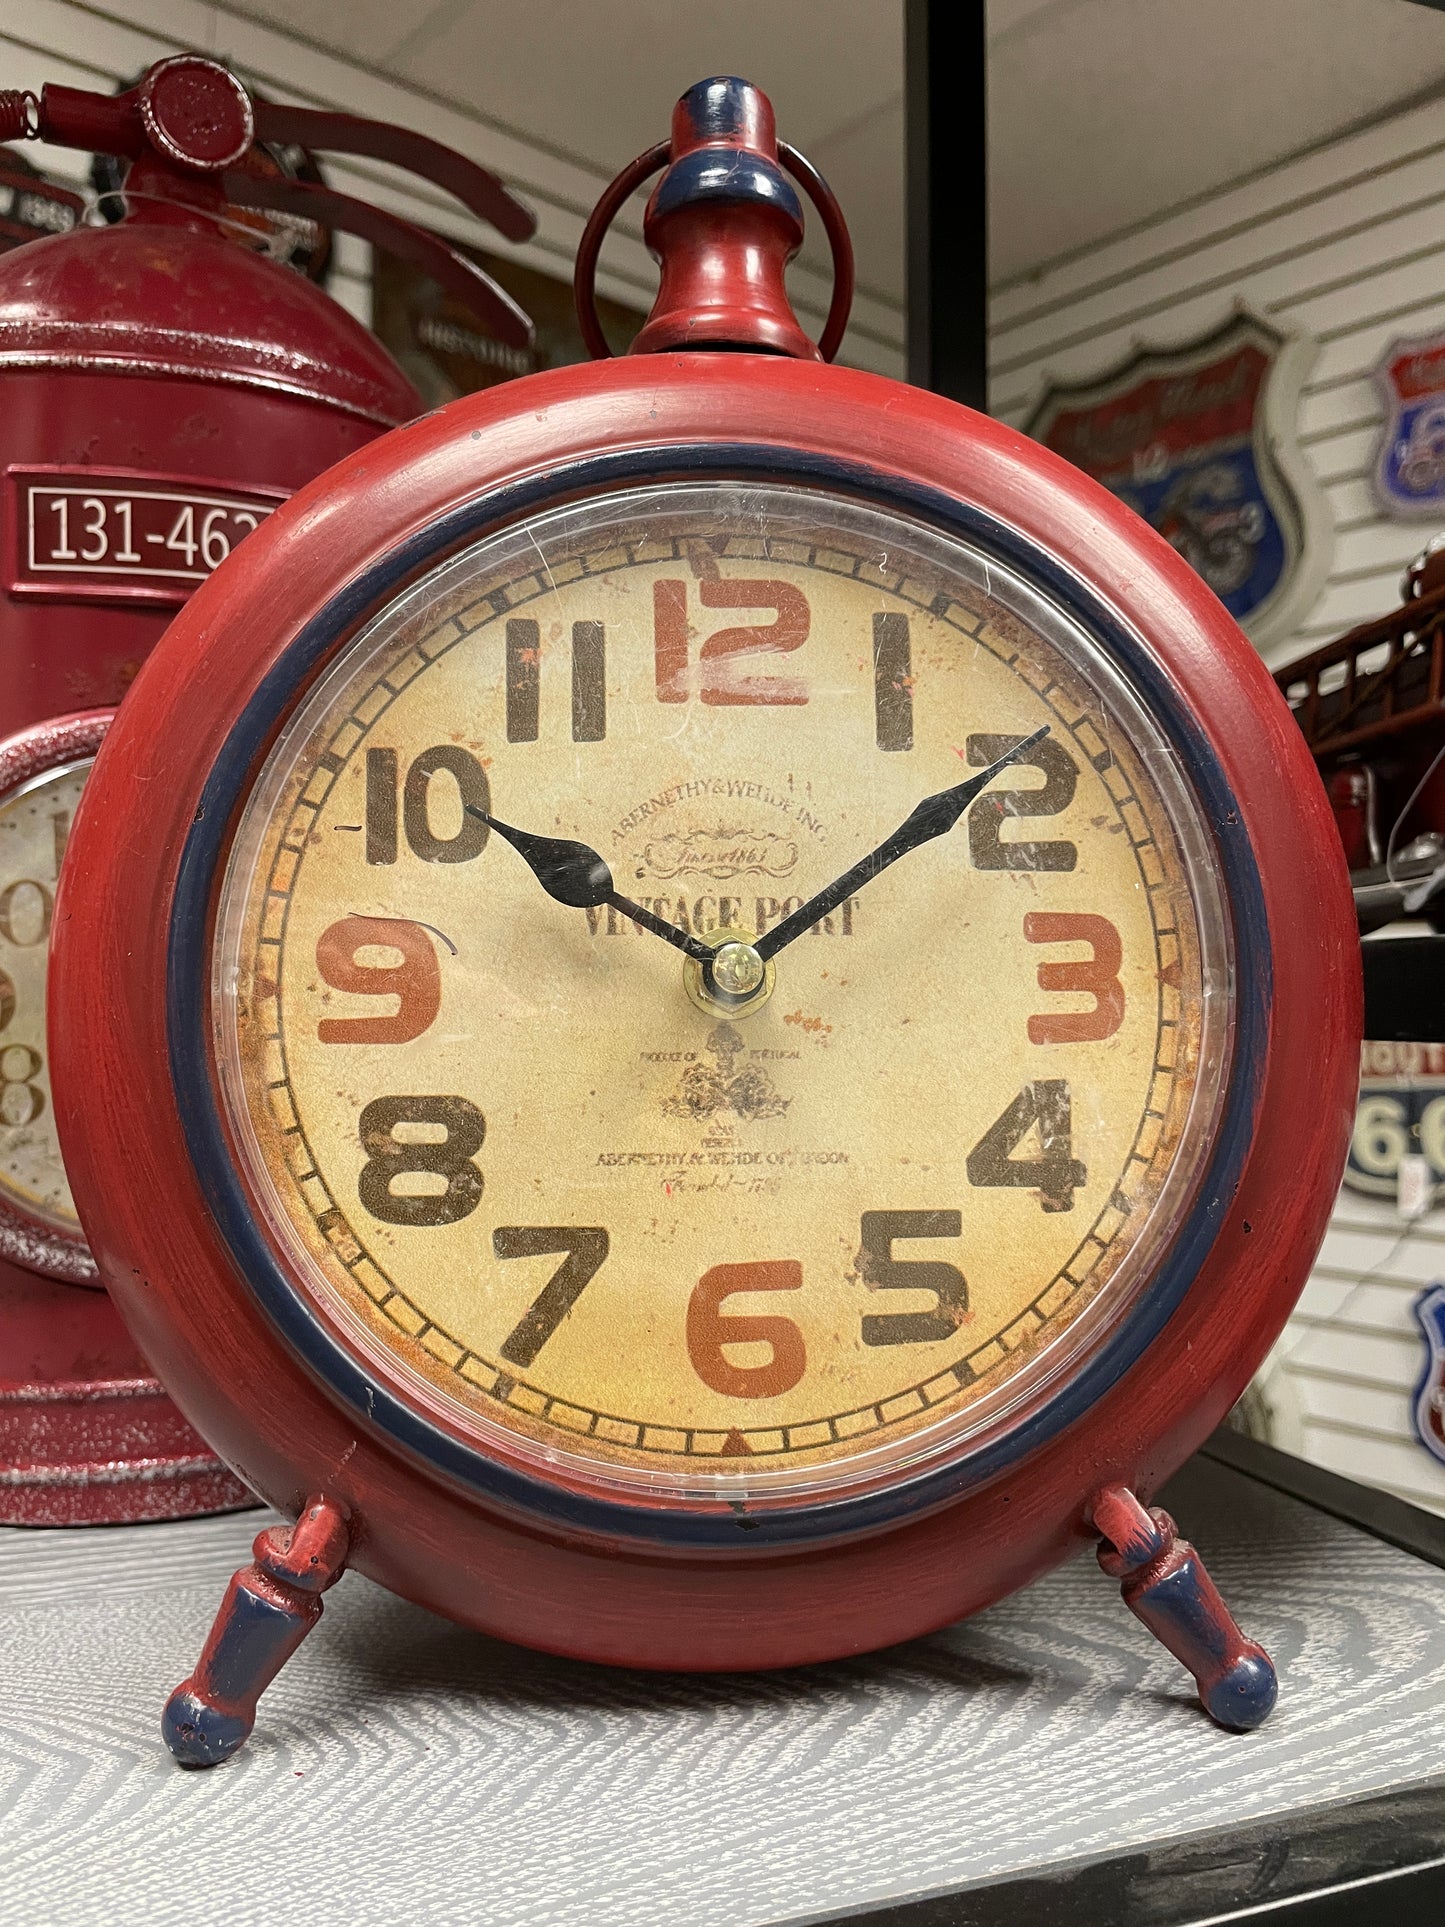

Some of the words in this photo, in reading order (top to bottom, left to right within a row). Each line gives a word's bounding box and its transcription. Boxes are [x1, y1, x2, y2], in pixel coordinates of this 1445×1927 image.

[506, 618, 607, 743] 11
[652, 579, 811, 706] 12
[872, 612, 914, 752] 1
[366, 745, 491, 866] 10
[966, 733, 1080, 872] 2
[316, 916, 442, 1045] 9
[1023, 911, 1126, 1045] 3
[358, 1095, 487, 1227] 8
[966, 1078, 1087, 1213] 4
[493, 1226, 610, 1369] 7
[686, 1259, 807, 1399] 6
[861, 1209, 969, 1347] 5
